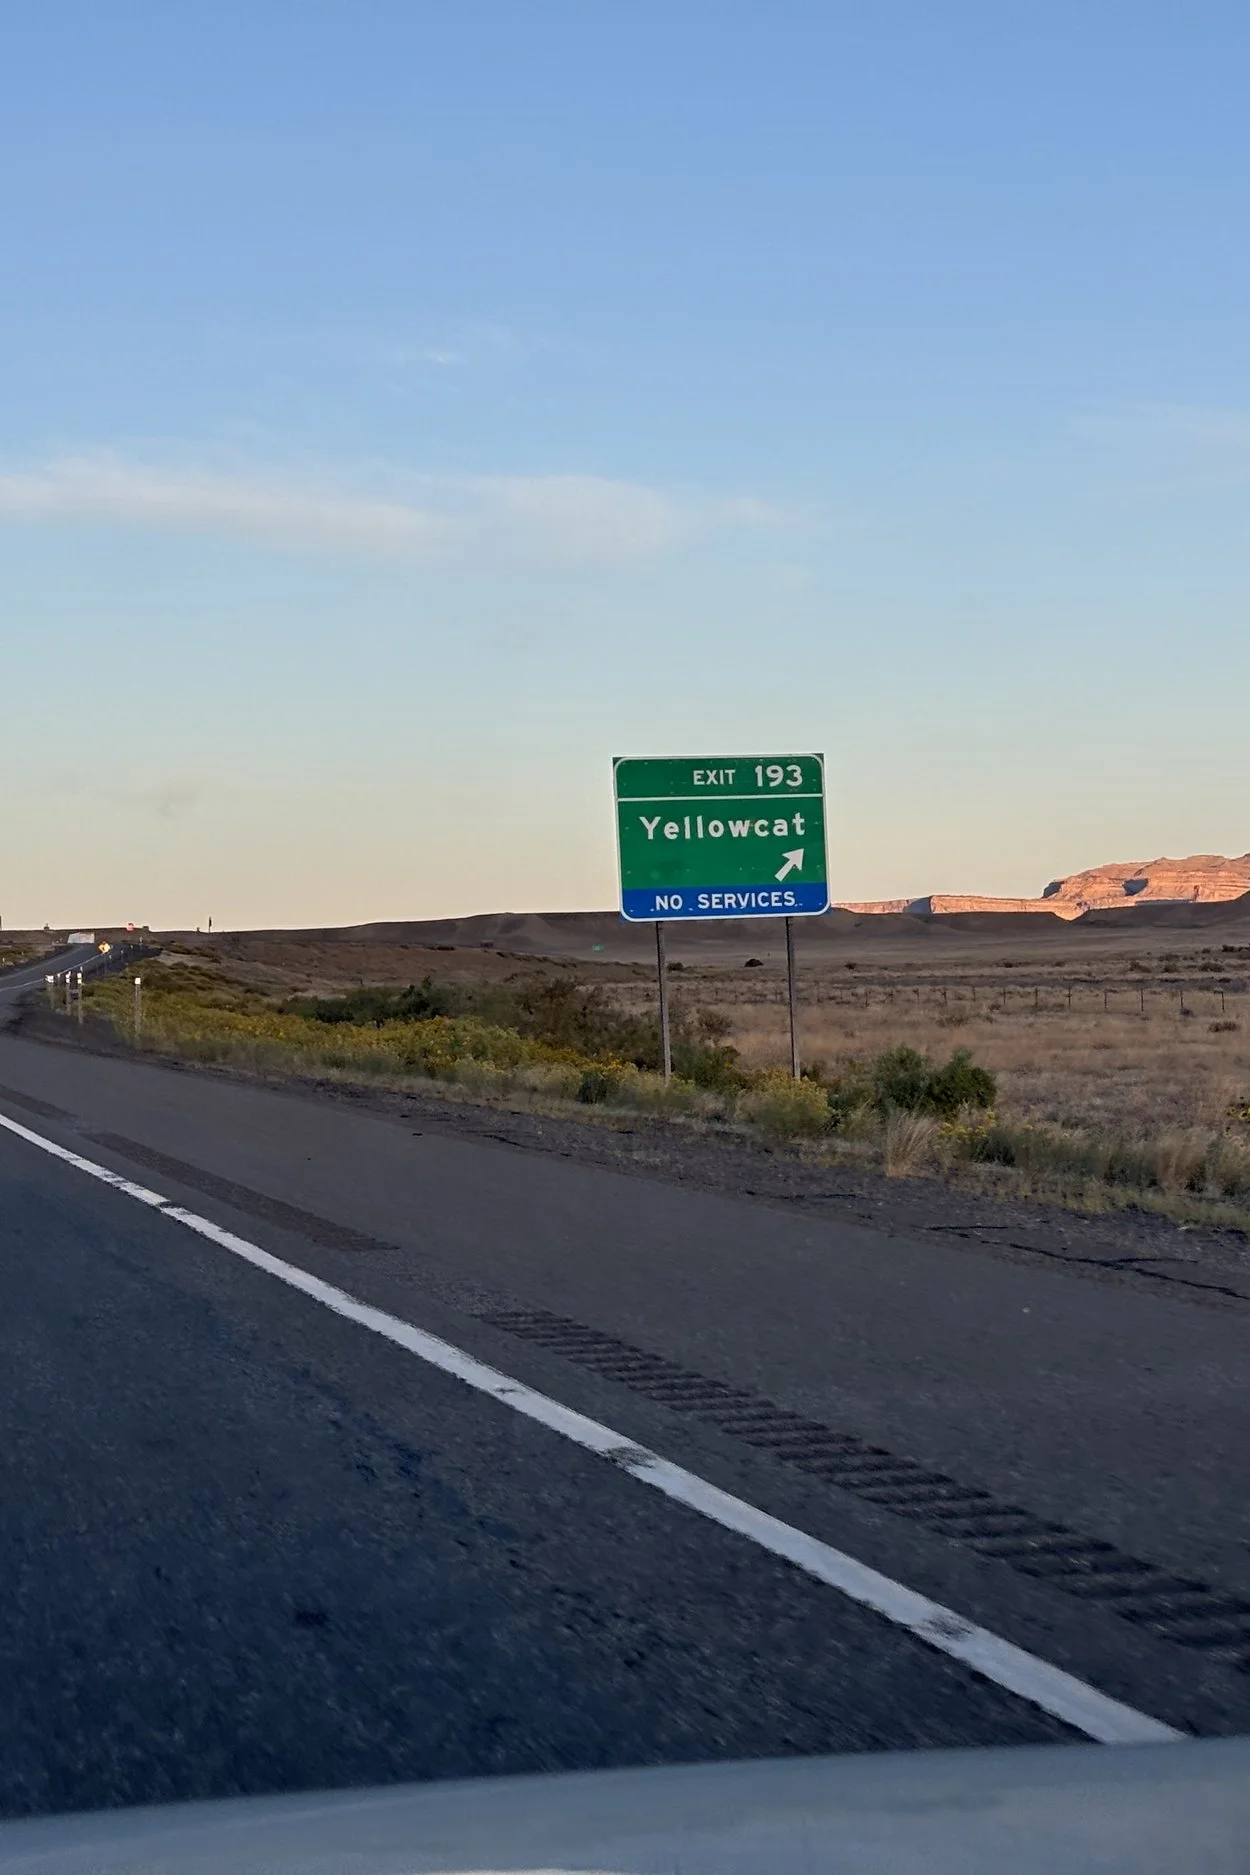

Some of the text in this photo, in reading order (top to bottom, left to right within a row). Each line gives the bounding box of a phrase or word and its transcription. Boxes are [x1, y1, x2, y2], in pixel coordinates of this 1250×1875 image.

[693, 765, 803, 787] EXIT 193
[639, 812, 805, 840] Yellowcat
[656, 891, 795, 910] NO SERVICES
